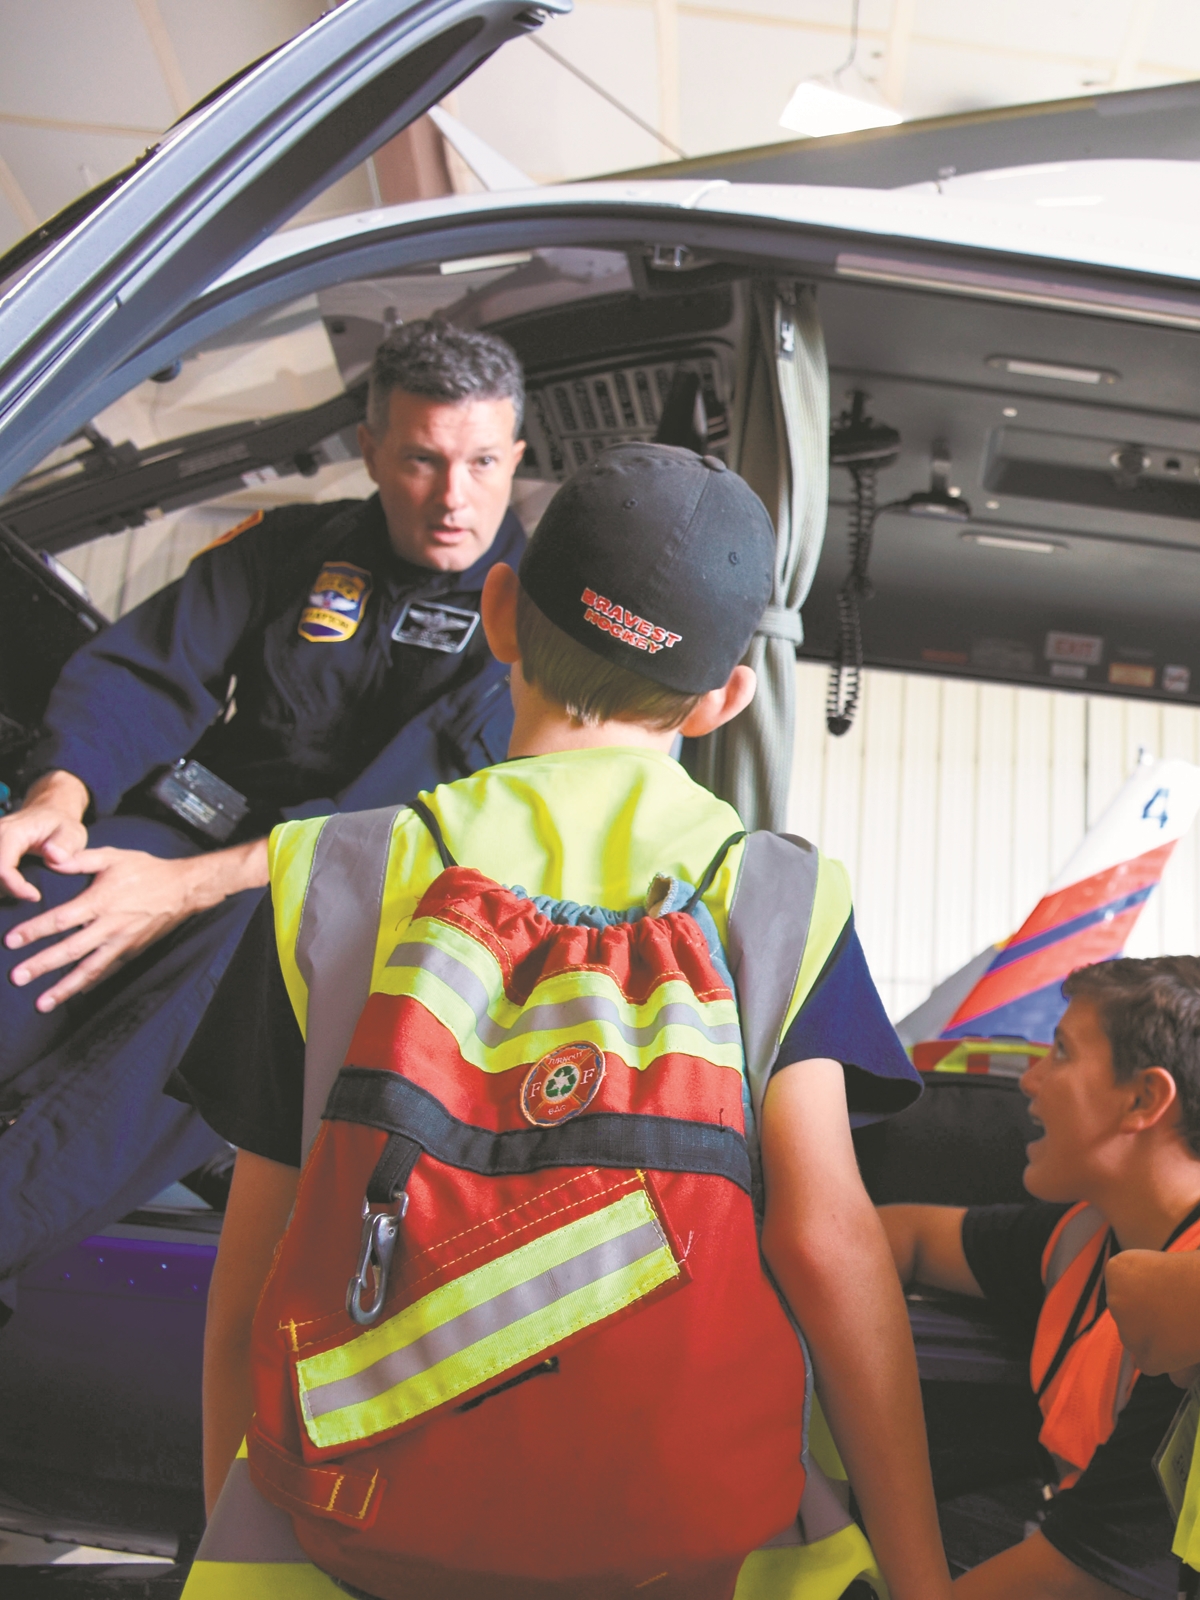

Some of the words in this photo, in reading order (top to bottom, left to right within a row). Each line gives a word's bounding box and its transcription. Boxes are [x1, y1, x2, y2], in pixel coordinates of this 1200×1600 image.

[581, 587, 682, 648] BRAVEST
[583, 607, 664, 654] HOCKEY
[1142, 787, 1169, 829] 4
[529, 1081, 542, 1099] F
[580, 1068, 595, 1085] F
[547, 1104, 567, 1115] BAG
